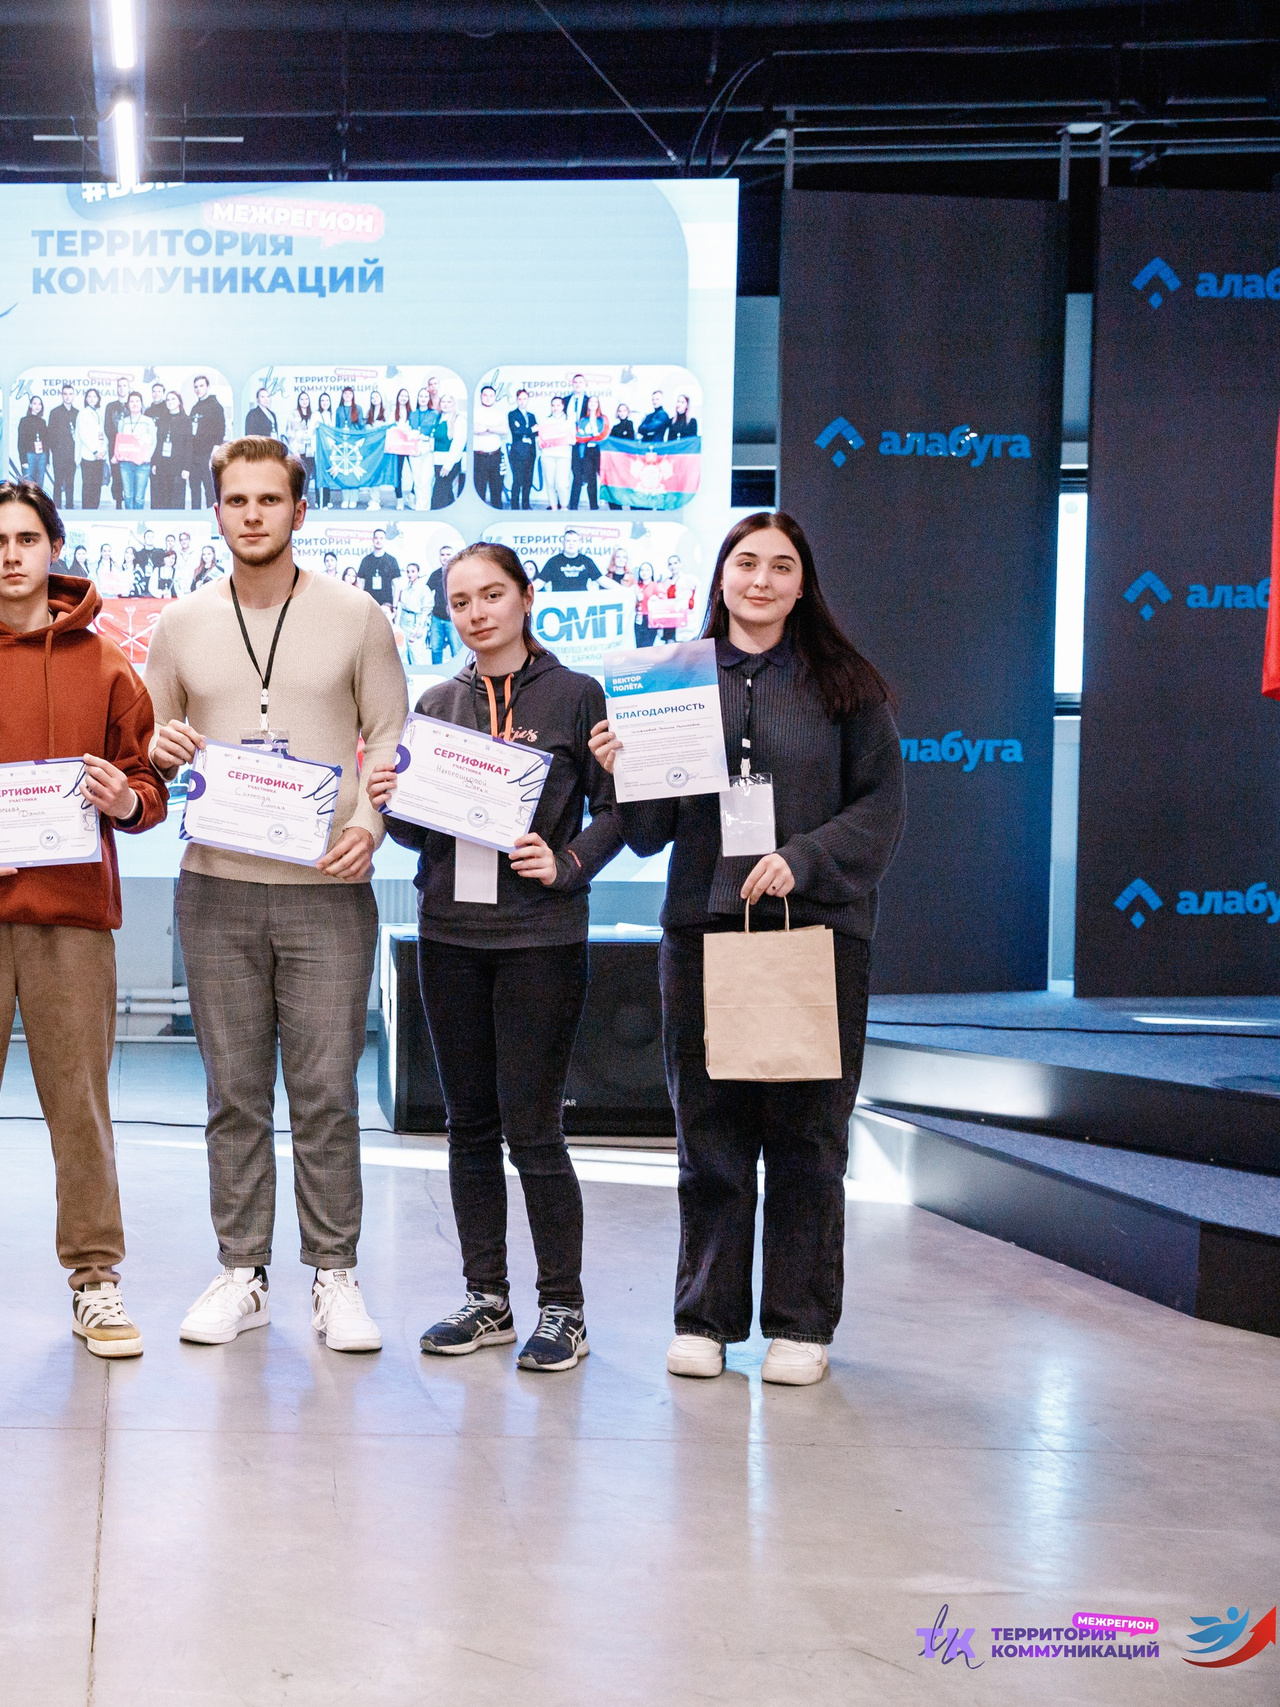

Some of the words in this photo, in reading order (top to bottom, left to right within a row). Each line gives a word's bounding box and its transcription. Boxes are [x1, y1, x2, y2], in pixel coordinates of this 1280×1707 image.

[213, 202, 374, 233] МЕЖРЕГИОН
[31, 229, 293, 258] ТЕРРИТОРИЯ
[32, 258, 384, 298] КОММУНИКАЦИЙ
[1195, 271, 1280, 299] алаб
[879, 424, 1032, 467] алабуга
[1186, 579, 1271, 608] алаб
[612, 676, 641, 685] ВЕКТОР
[613, 683, 643, 692] ПОЛЁТА
[616, 702, 705, 720] БЛАГОДАРНОСТЬ
[433, 747, 511, 777] СЕРТИФИКАТ
[901, 730, 1024, 772] лабуга
[227, 770, 304, 792] СЕРТИФИКАТ
[1176, 882, 1280, 923] алабу
